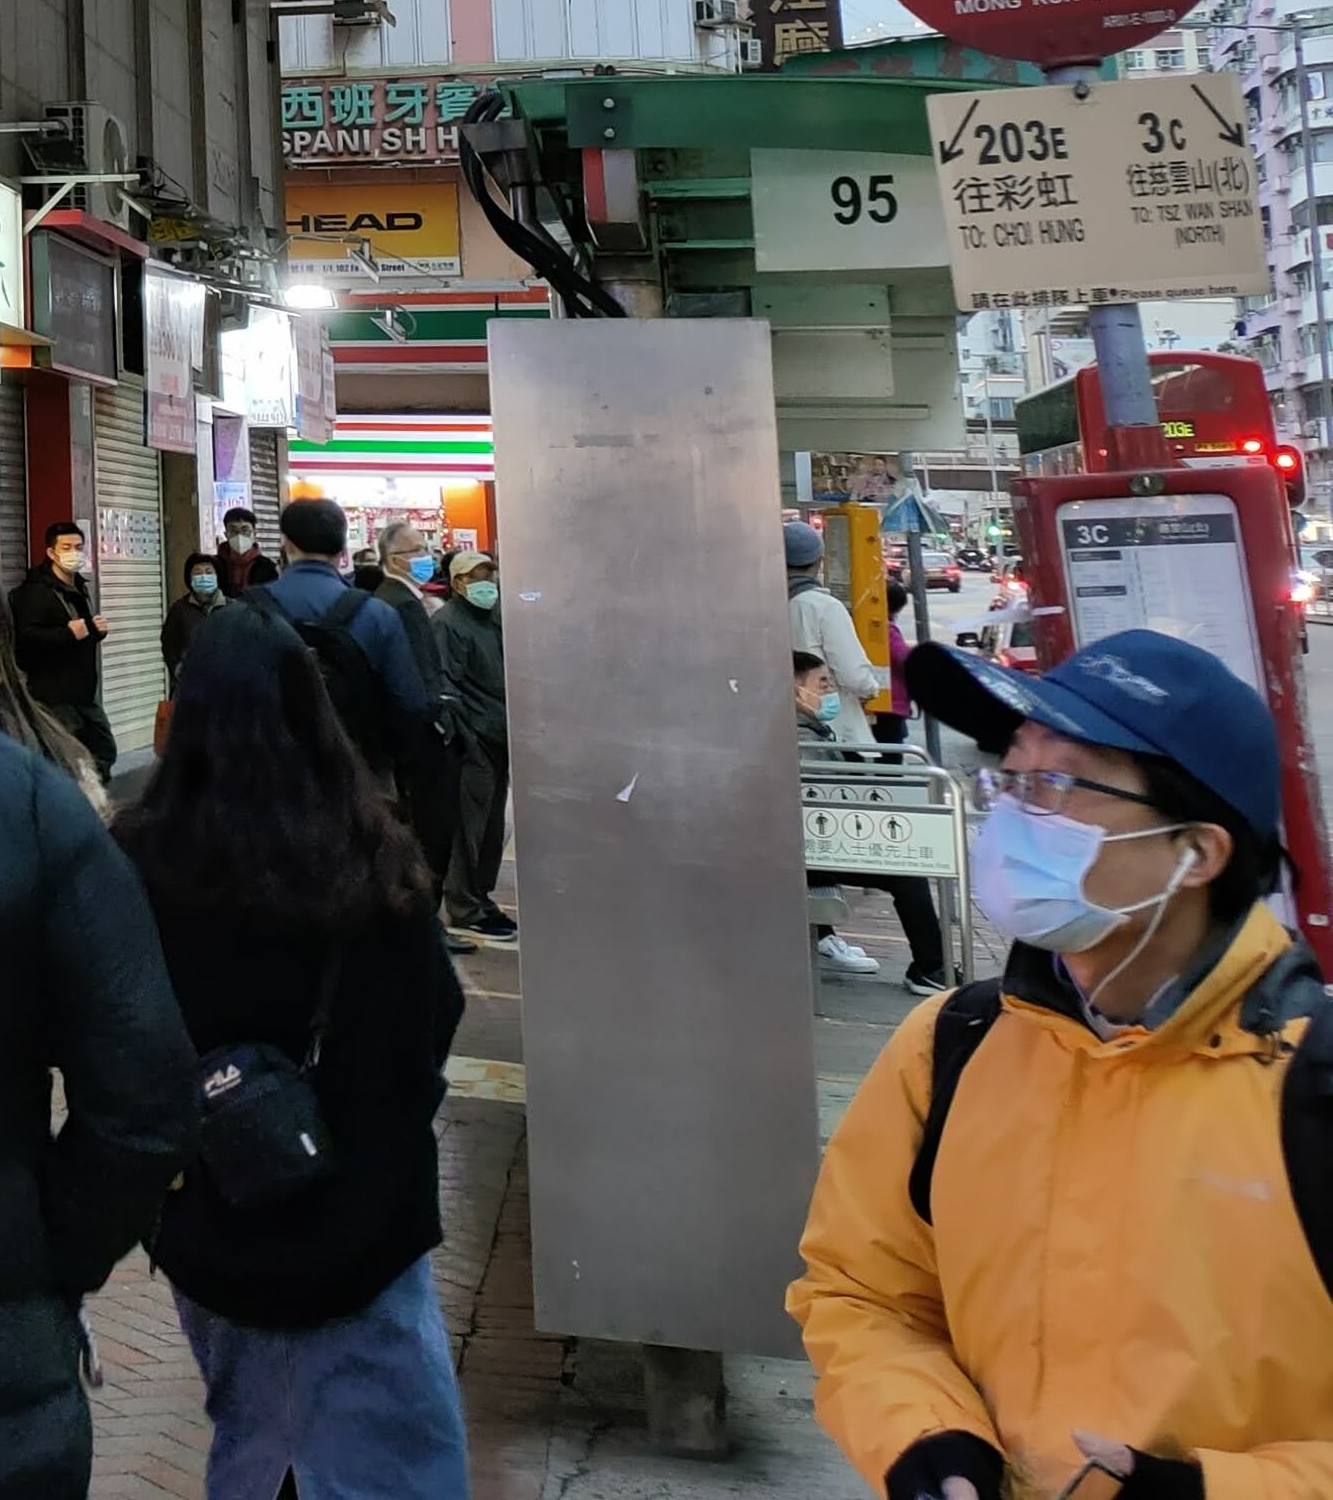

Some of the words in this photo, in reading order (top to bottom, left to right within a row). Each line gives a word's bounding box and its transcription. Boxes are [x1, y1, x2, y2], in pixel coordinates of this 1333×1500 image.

[973, 119, 1069, 165] 203E
[1137, 111, 1187, 154] 3C
[1126, 155, 1250, 198] 往慈雲山(北)
[830, 174, 898, 226] 95
[953, 172, 1079, 215] 往彩虹
[286, 211, 424, 233] HEAD
[1156, 204, 1182, 223] TSZ
[1184, 201, 1214, 221] WAN
[1218, 199, 1253, 218] SHAN
[959, 223, 986, 250] TO:
[992, 220, 1034, 247] CHOI
[1039, 217, 1086, 245] HUNG
[1174, 224, 1226, 250] (NORTH)
[971, 286, 1110, 309] 請在此排隊上車
[1118, 288, 1162, 299] Please
[1165, 286, 1206, 298] queue
[1207, 283, 1238, 295] here
[1076, 523, 1110, 546] 3C
